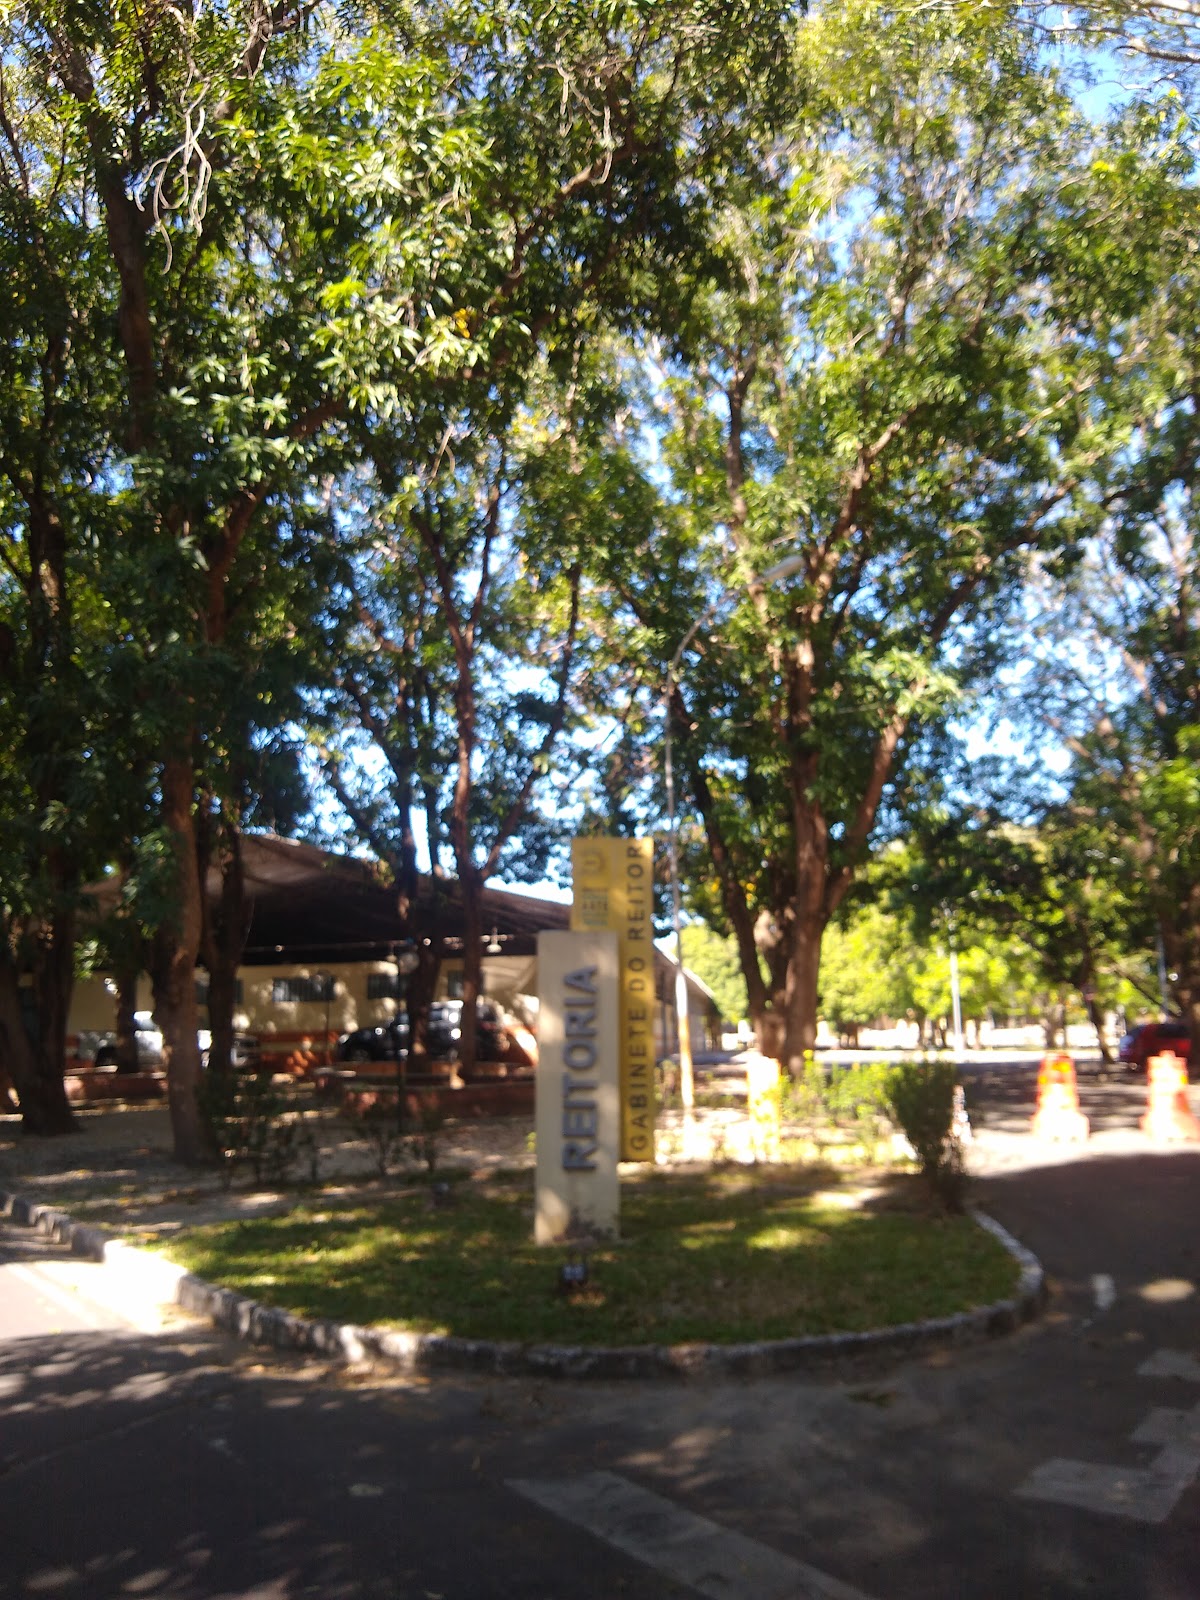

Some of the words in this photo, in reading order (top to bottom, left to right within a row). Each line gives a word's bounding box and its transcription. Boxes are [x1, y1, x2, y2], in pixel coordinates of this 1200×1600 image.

[627, 845, 645, 940] REITOR
[628, 956, 646, 992] DO
[562, 965, 598, 1170] REITORIA
[628, 1007, 648, 1151] GABINETE
